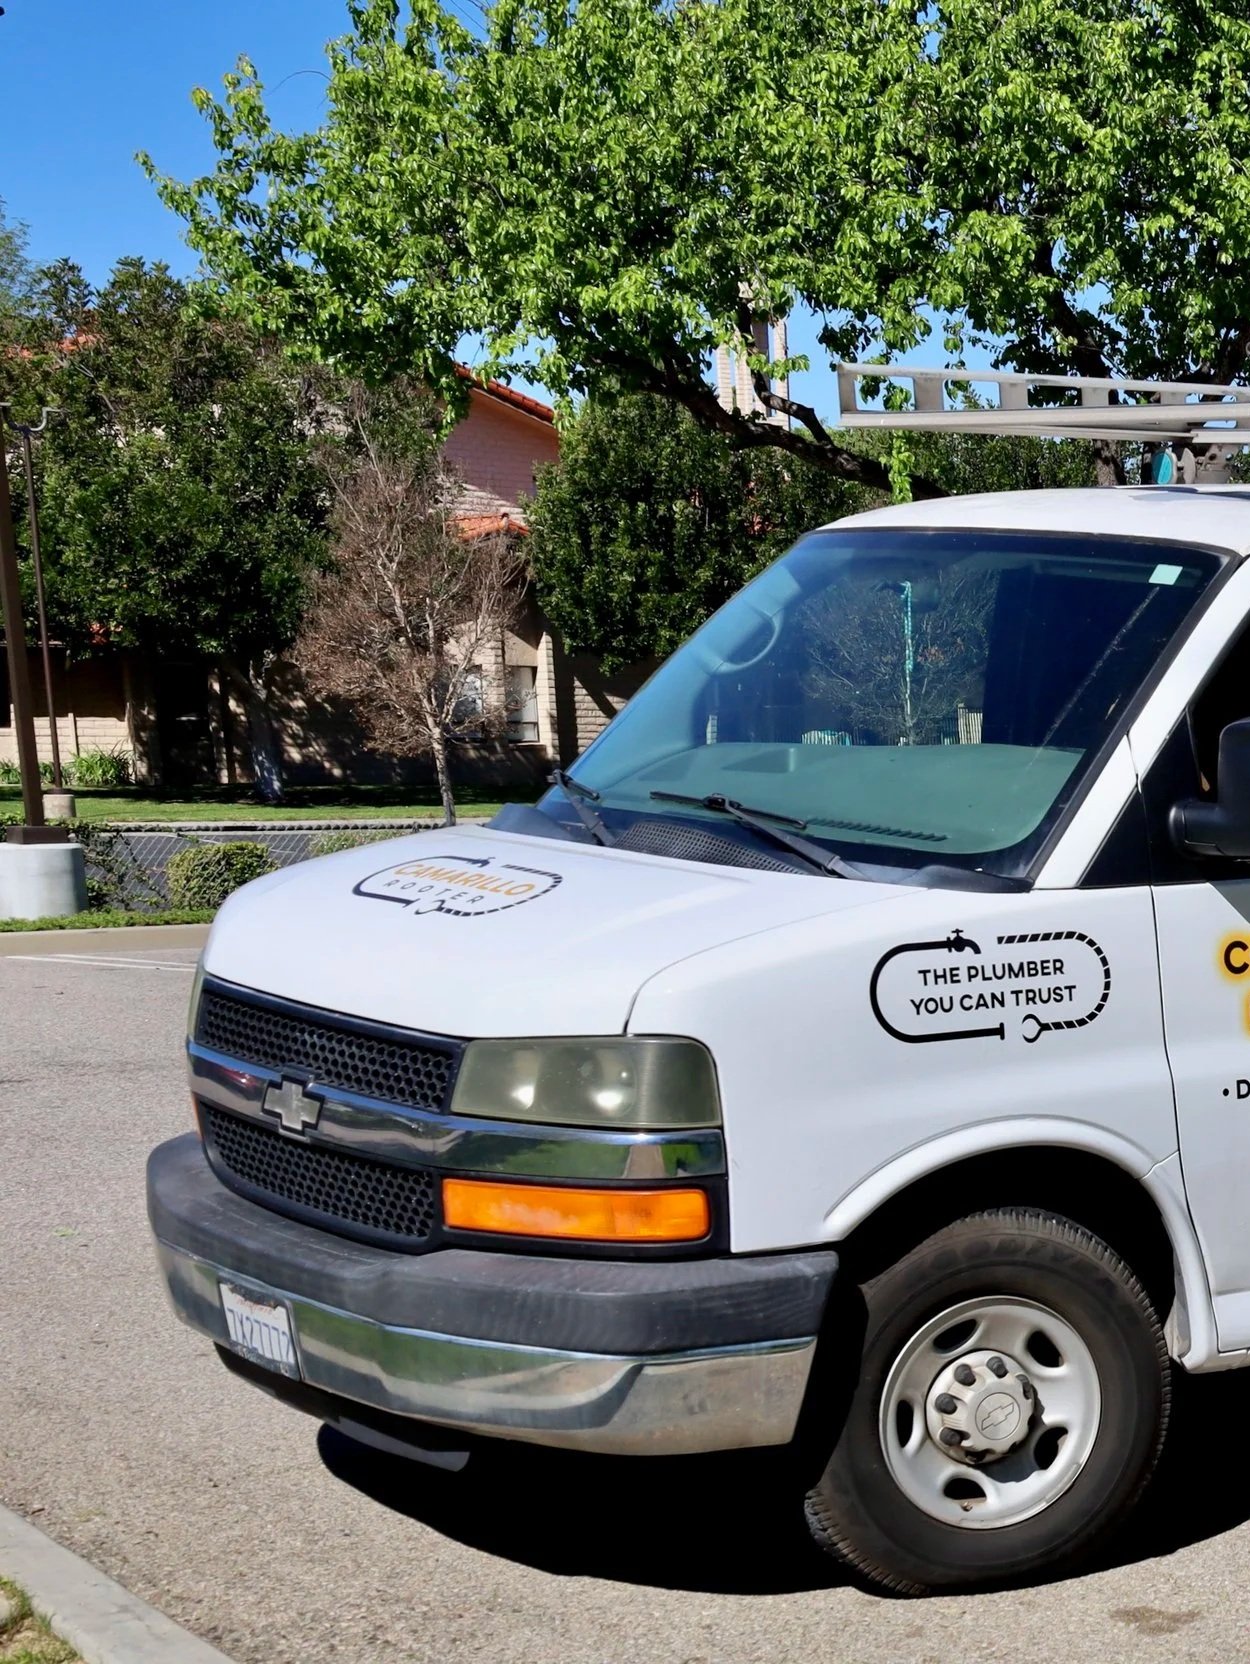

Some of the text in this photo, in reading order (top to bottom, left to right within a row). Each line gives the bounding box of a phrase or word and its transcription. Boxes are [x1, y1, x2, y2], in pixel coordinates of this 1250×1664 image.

[383, 879, 485, 904] ROOTER
[394, 864, 536, 896] CAMARILLO
[918, 959, 1064, 986] THE PLUMBER
[910, 985, 1076, 1015] YOU CAN TRUST
